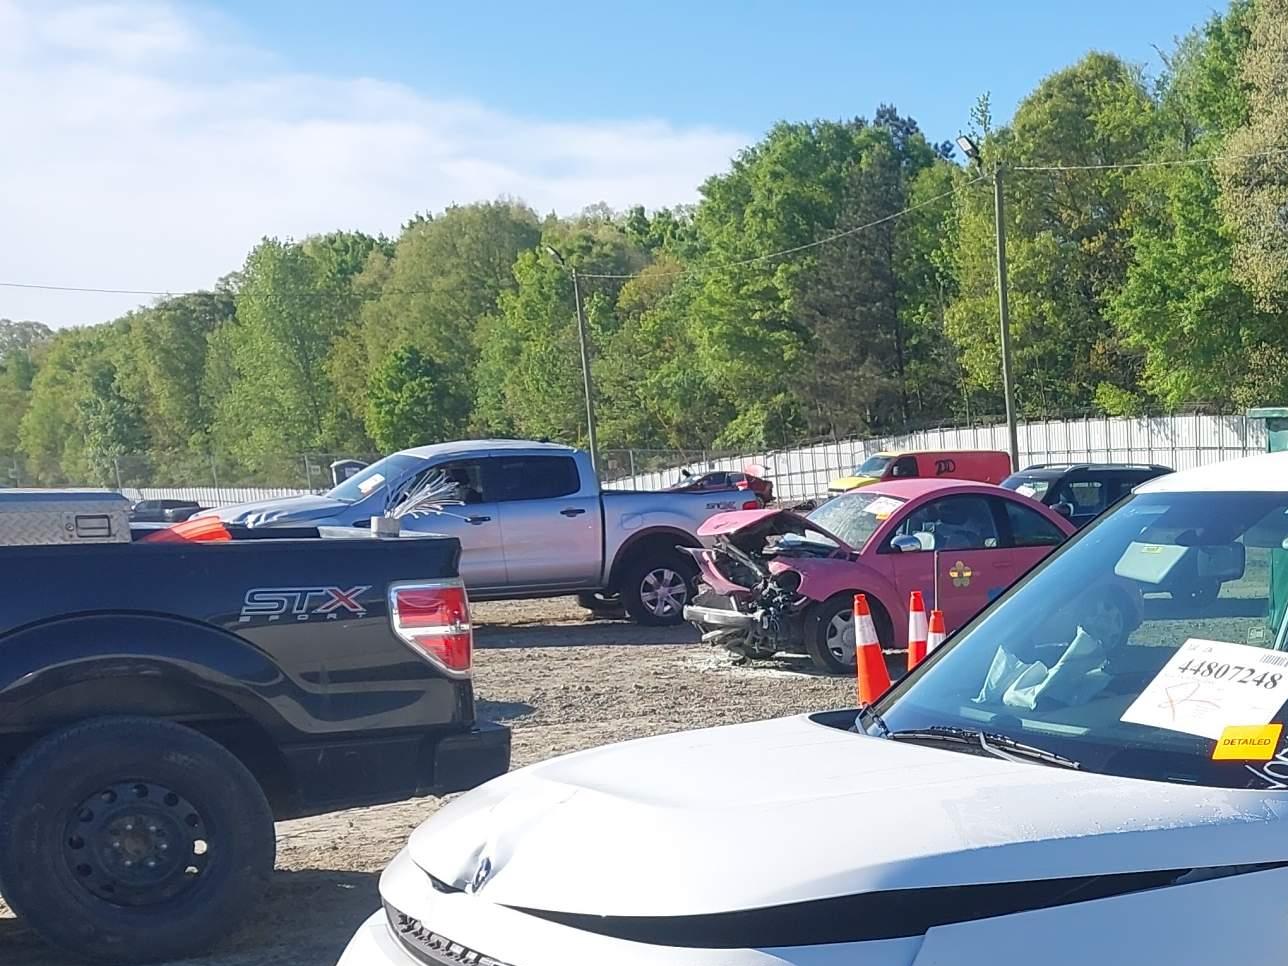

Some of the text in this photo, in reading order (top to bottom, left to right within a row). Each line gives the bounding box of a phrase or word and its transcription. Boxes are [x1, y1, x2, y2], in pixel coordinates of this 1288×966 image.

[240, 585, 373, 615] STX
[1178, 657, 1283, 690] 44807248
[1223, 738, 1271, 746] DETAILED
